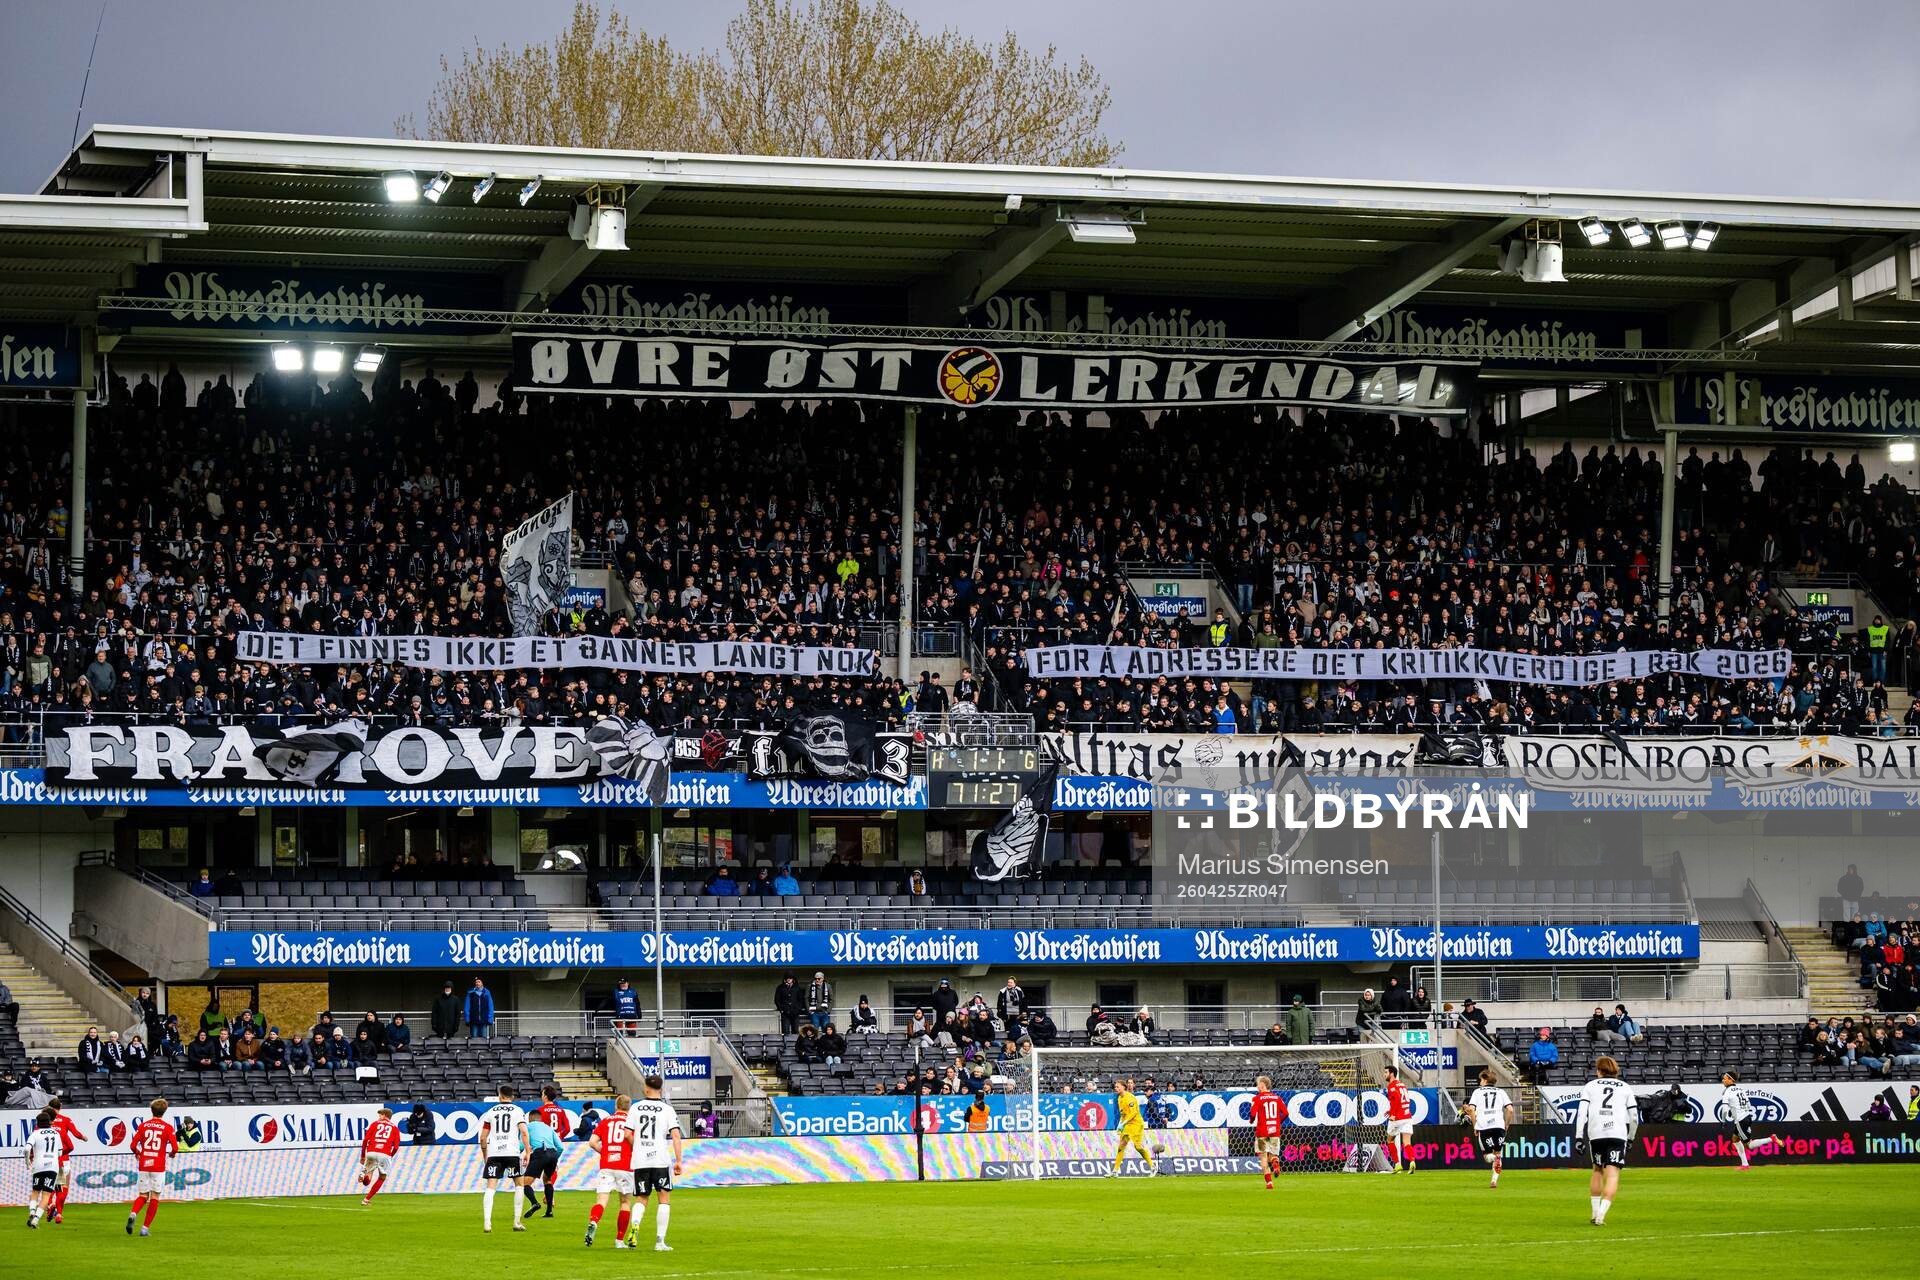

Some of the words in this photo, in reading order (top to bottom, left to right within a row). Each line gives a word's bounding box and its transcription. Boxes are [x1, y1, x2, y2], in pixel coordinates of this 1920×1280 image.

[531, 340, 732, 388] ØVRE
[764, 348, 913, 391] ØST
[1020, 355, 1453, 408] LERKENDAL
[246, 633, 305, 660] DET
[319, 637, 431, 662] FINNES
[446, 640, 515, 665] IKKE
[531, 640, 567, 663] ET
[713, 644, 804, 671] LANGT
[816, 649, 875, 674] NOK
[1036, 649, 1089, 674] FOR
[1127, 648, 1298, 674] ADRESSERE
[1312, 652, 1366, 676] DET
[1382, 650, 1618, 682] KRITIKKVERDIGE
[1716, 649, 1789, 675] 2026
[1521, 741, 1775, 785] ROSENBORG
[953, 782, 1018, 804] 71:27
[251, 933, 411, 965] Adresseavisen
[448, 932, 606, 966] Adresseavisen
[829, 932, 980, 963] Adresseavisen
[1014, 931, 1161, 962] Adresseavisen
[1195, 930, 1339, 961] Adresseavisen
[1545, 927, 1684, 957] Adresseavisen
[1263, 1101, 1277, 1119] 10
[1483, 1091, 1497, 1109] 17
[1601, 1087, 1614, 1109] 2
[375, 1124, 392, 1139] 23
[494, 1113, 511, 1133] 10
[550, 1113, 558, 1130] 8
[607, 1120, 625, 1144] 16
[639, 1114, 657, 1140] 21
[781, 1109, 907, 1134] SpareBank
[950, 1109, 1074, 1132] SareBank
[1086, 1107, 1096, 1129] 1
[44, 1136, 56, 1153] 11
[143, 1130, 163, 1151] 25
[1444, 1136, 1475, 1164] på
[1642, 1136, 1667, 1158] Vi
[1672, 1139, 1698, 1157] er
[1826, 1132, 1855, 1159] på
[1174, 1158, 1240, 1173] SPORT
[76, 1167, 212, 1191] cop
